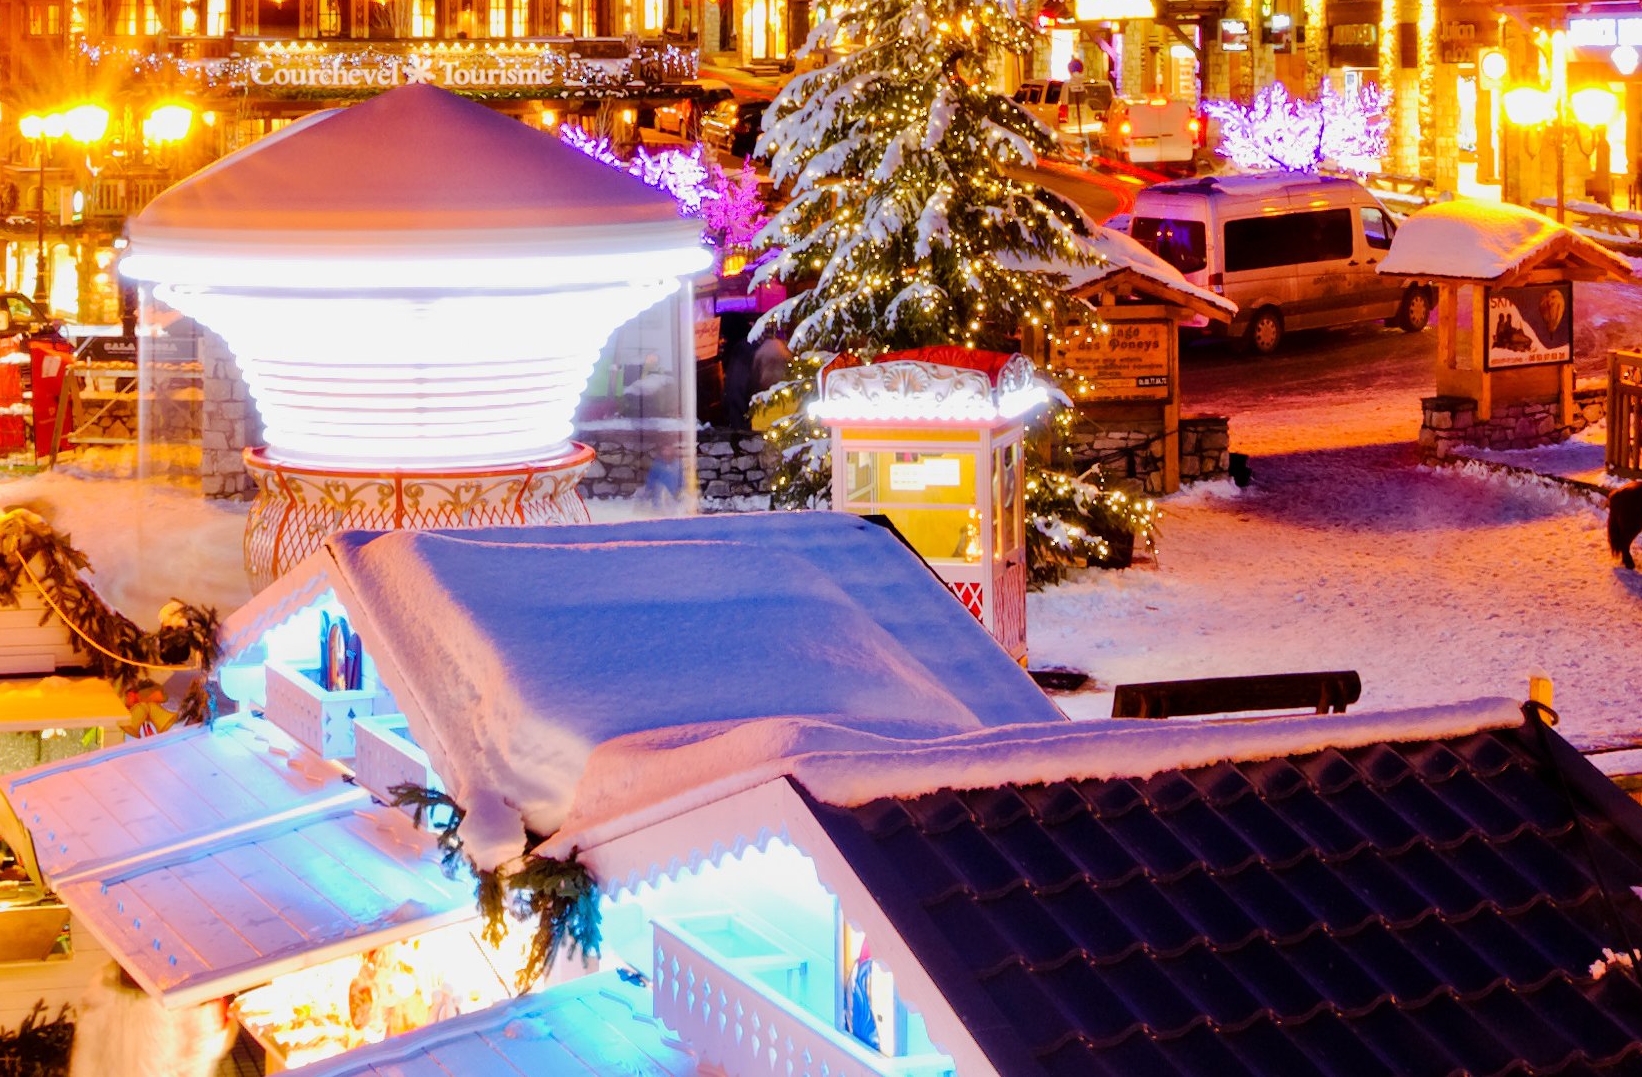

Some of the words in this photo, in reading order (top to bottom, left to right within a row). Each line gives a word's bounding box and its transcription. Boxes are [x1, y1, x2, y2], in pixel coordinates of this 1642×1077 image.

[252, 59, 399, 87] Courchevel
[439, 57, 555, 86] Tourisme
[1108, 338, 1160, 352] Poneys
